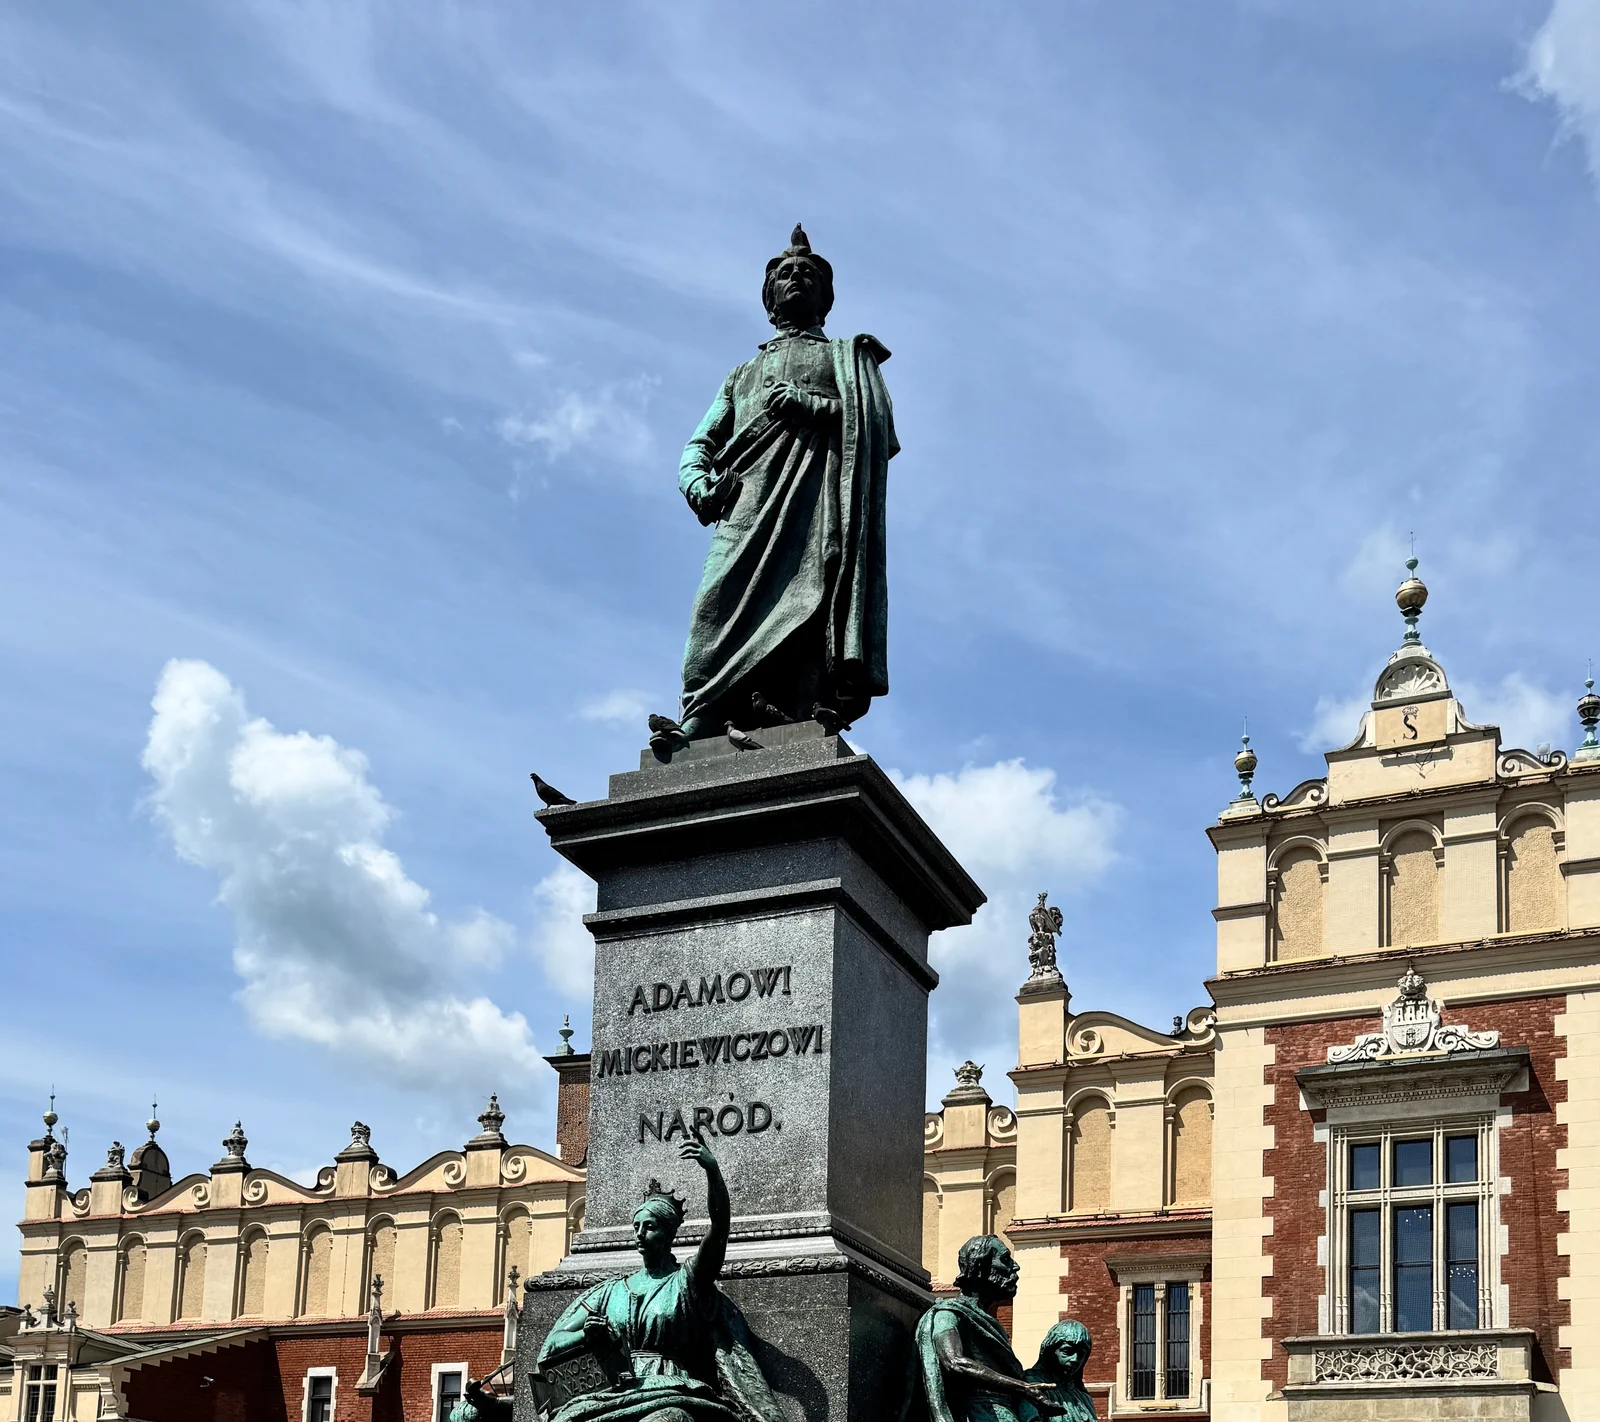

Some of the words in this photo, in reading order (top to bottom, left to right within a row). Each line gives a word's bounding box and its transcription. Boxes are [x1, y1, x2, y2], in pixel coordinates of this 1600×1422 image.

[1403, 714, 1418, 740] S
[627, 966, 791, 1015] ADAMOWI
[598, 1025, 823, 1078] MICKIEWICZOWI
